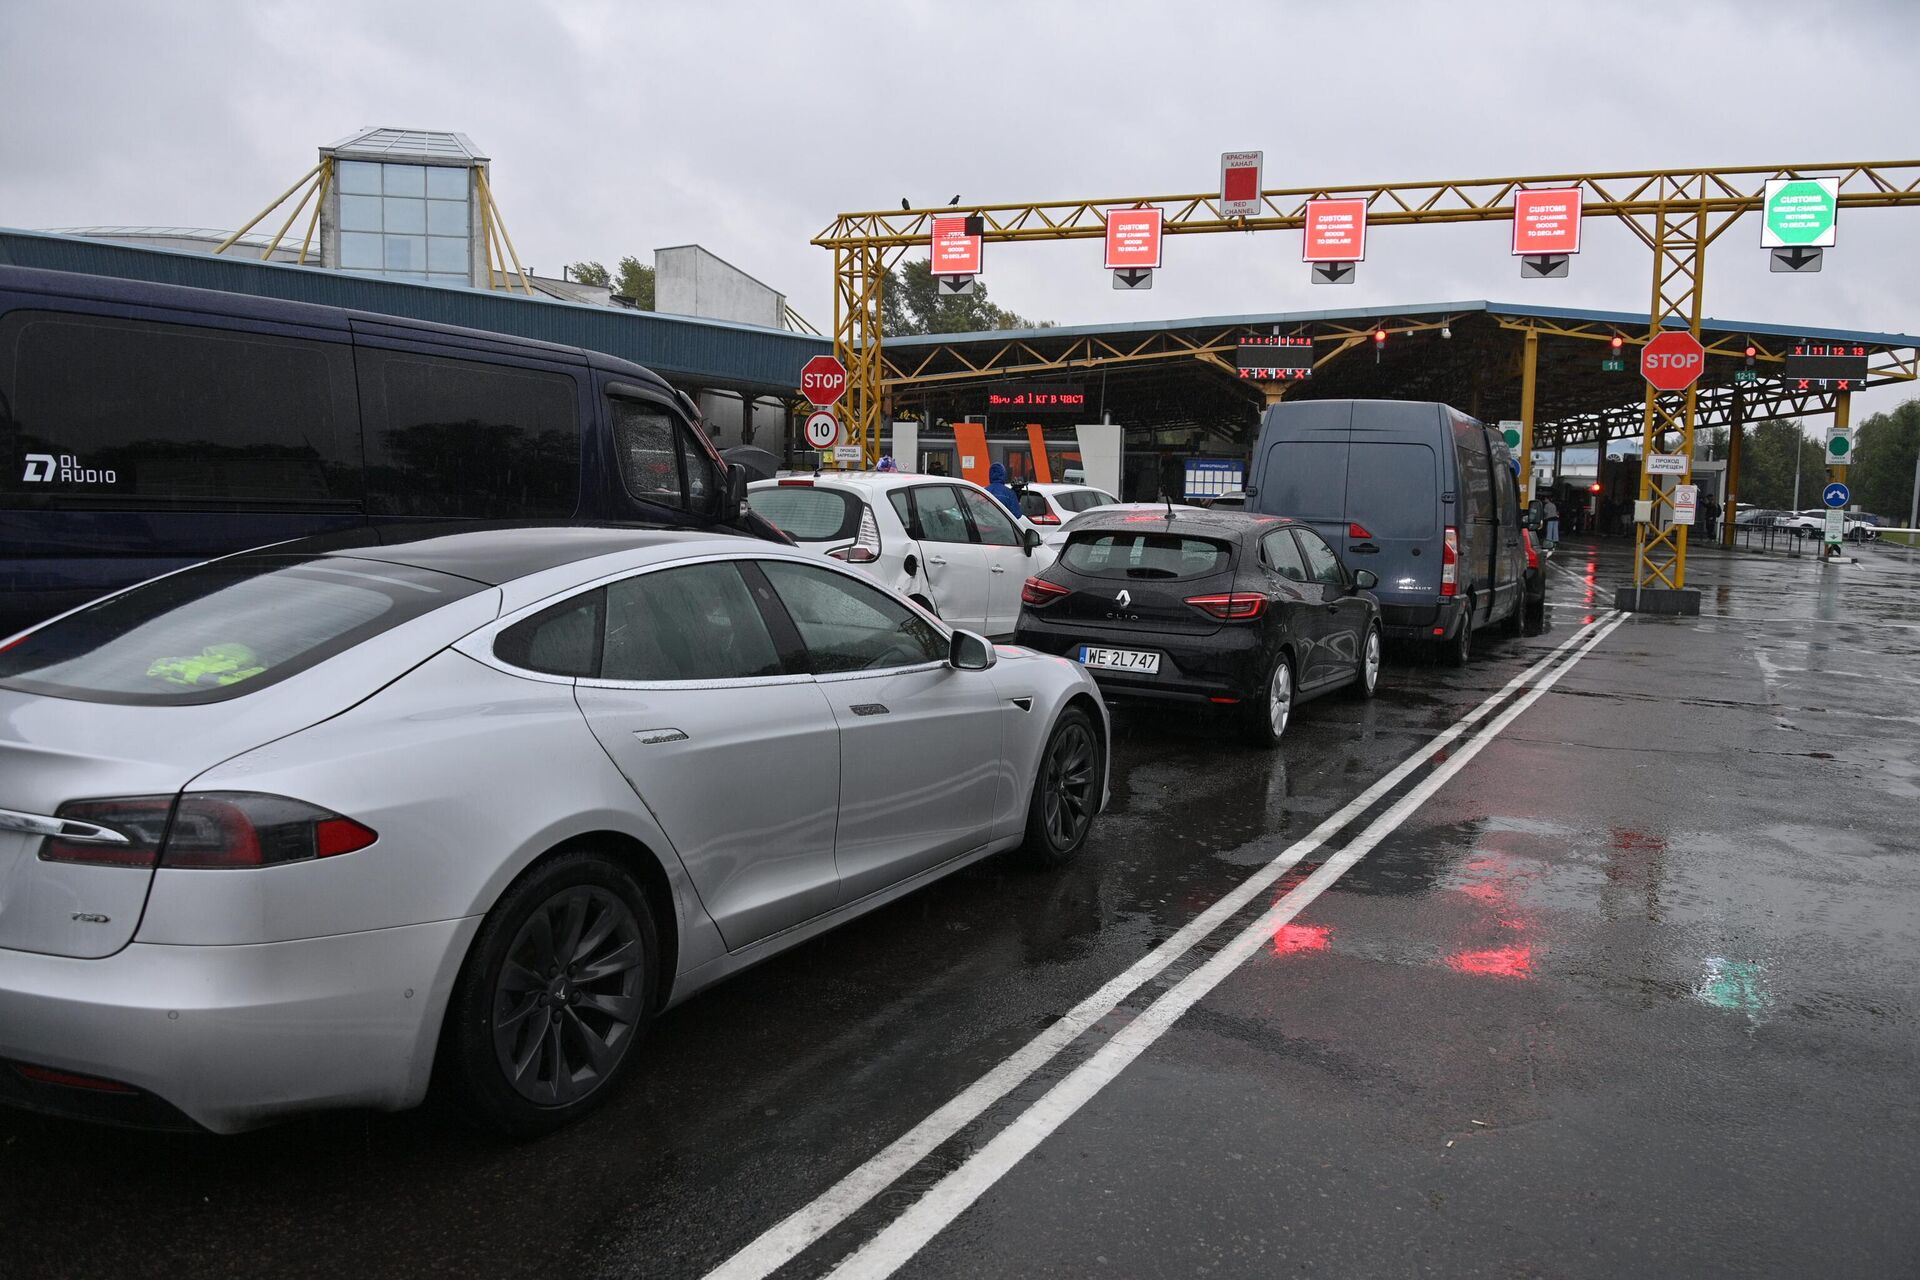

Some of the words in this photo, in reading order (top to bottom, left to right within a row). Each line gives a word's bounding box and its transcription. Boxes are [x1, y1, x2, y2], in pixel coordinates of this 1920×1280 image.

[1118, 223, 1150, 231] CUSTOMS
[1832, 347, 1844, 355] 12
[1852, 347, 1864, 355] 13
[1608, 361, 1618, 370] 11
[1646, 353, 1699, 369] STOP
[804, 373, 843, 388] STOP
[1736, 372, 1756, 380] 12-13
[1028, 393, 1033, 404] 1
[1035, 395, 1048, 404] кг
[1050, 395, 1057, 404] в
[813, 422, 830, 437] 10
[60, 455, 81, 468] DL
[61, 469, 116, 483] AUDIO
[1106, 612, 1139, 620] CLIO
[1088, 649, 1107, 665] WE
[1111, 651, 1156, 669] 2L747
